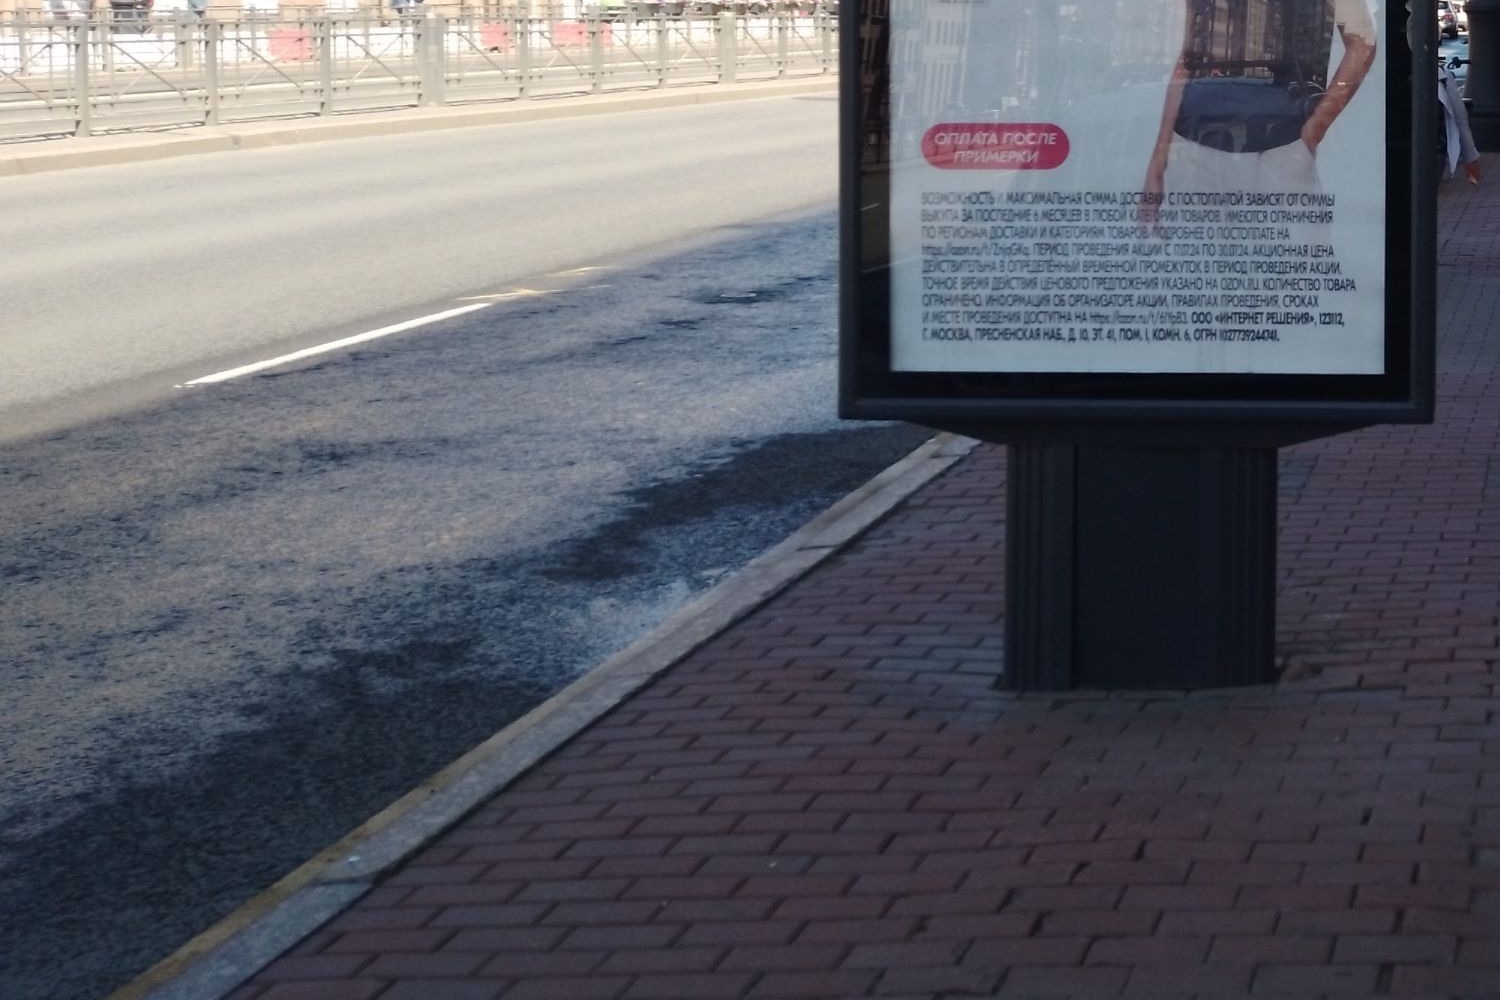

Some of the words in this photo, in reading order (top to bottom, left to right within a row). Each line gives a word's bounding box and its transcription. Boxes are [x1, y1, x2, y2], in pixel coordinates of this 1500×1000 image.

[934, 132, 999, 145] ОПЛАТА
[1002, 132, 1058, 145] ПОСЛЕ
[953, 150, 1040, 163] ПРИМЕРКИ
[1084, 192, 1117, 205] СУММА
[1287, 193, 1298, 206] ОТ
[1278, 227, 1290, 240] НА
[1323, 278, 1357, 291] ТОВАРА
[1283, 295, 1319, 308] СРОКАХ
[1191, 312, 1212, 325] ООО
[975, 328, 1041, 341] ПРЕСНЕНСКАЯ
[1193, 329, 1217, 342] ОГРН
